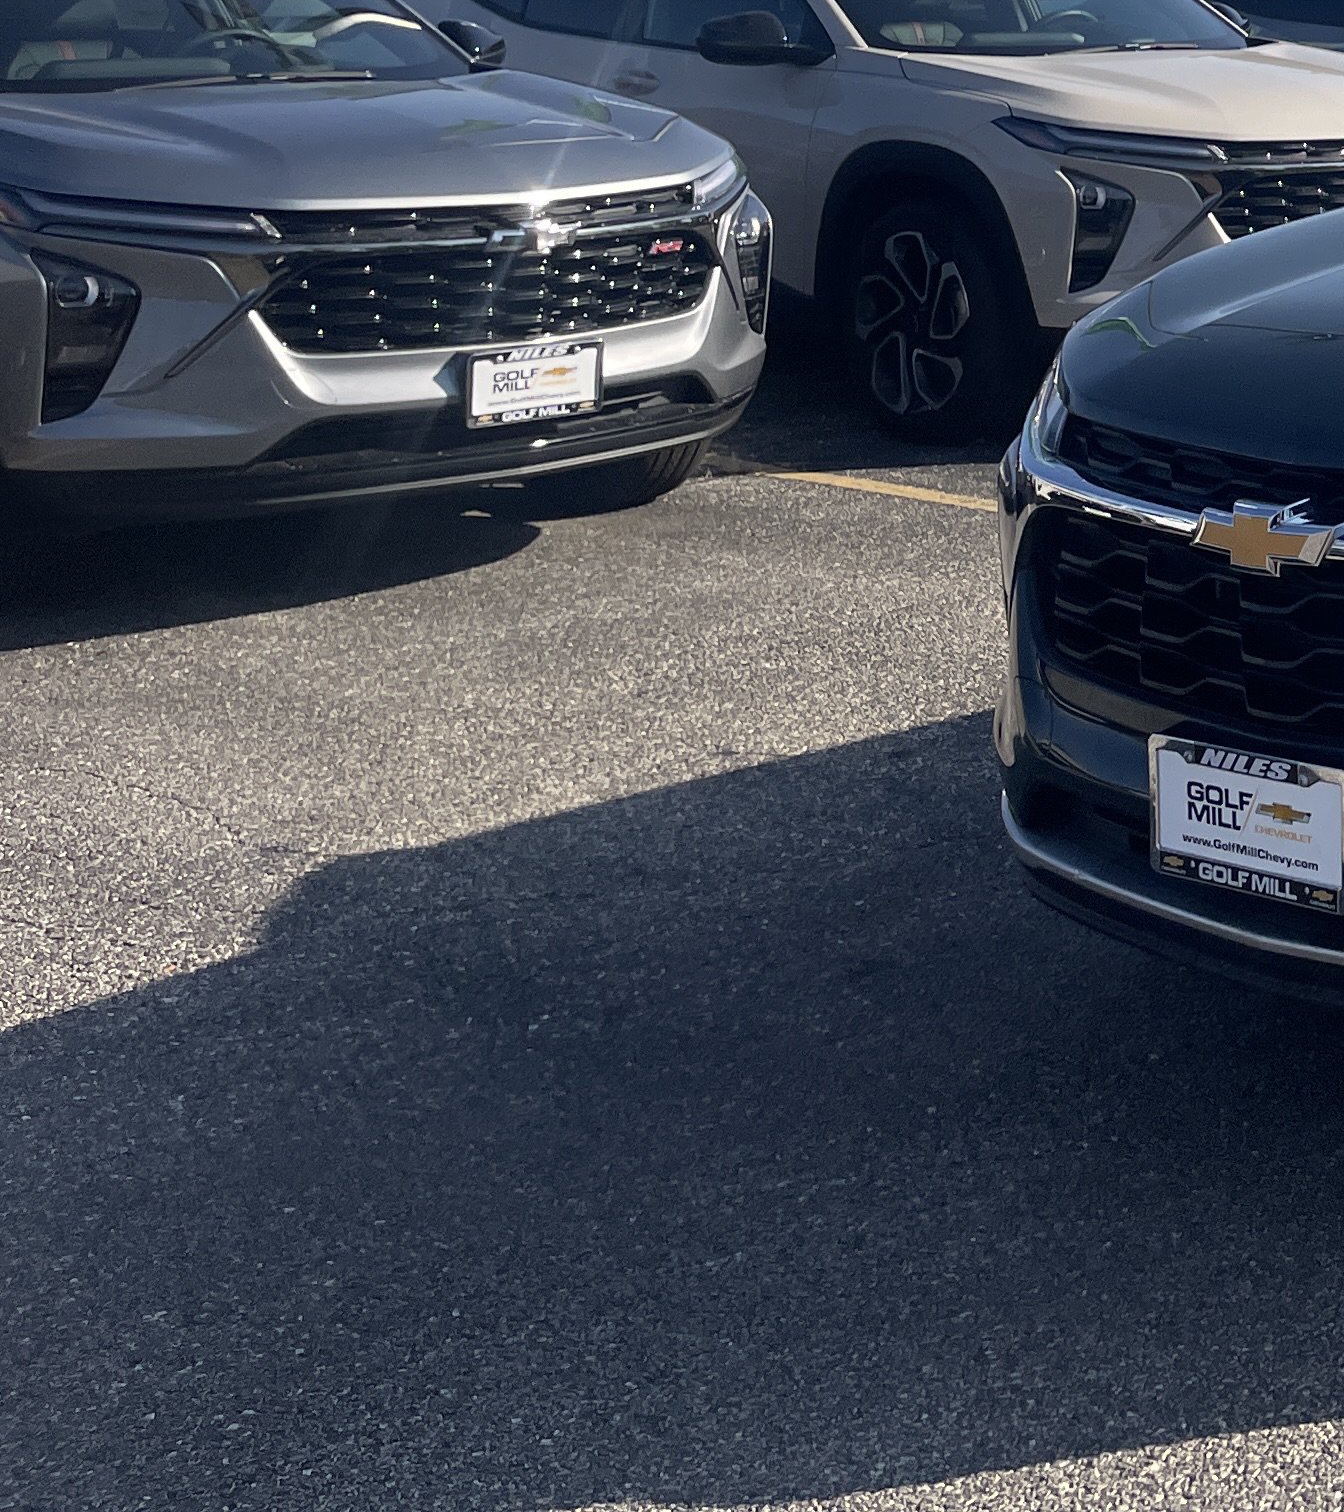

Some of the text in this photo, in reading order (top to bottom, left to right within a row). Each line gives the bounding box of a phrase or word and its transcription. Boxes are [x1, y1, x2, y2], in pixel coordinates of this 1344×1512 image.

[506, 343, 570, 363] NILES
[492, 379, 530, 394] MILL
[493, 367, 540, 383] GOLF
[501, 404, 571, 423] GOLF MILL
[1200, 748, 1292, 781] NILES
[1186, 780, 1254, 811] GOLF
[1187, 801, 1242, 831] MILL
[1254, 824, 1312, 844] CHEVROLET
[1182, 832, 1320, 872] www.GolfMillChevy.com
[1198, 861, 1298, 902] GOLF MILL
